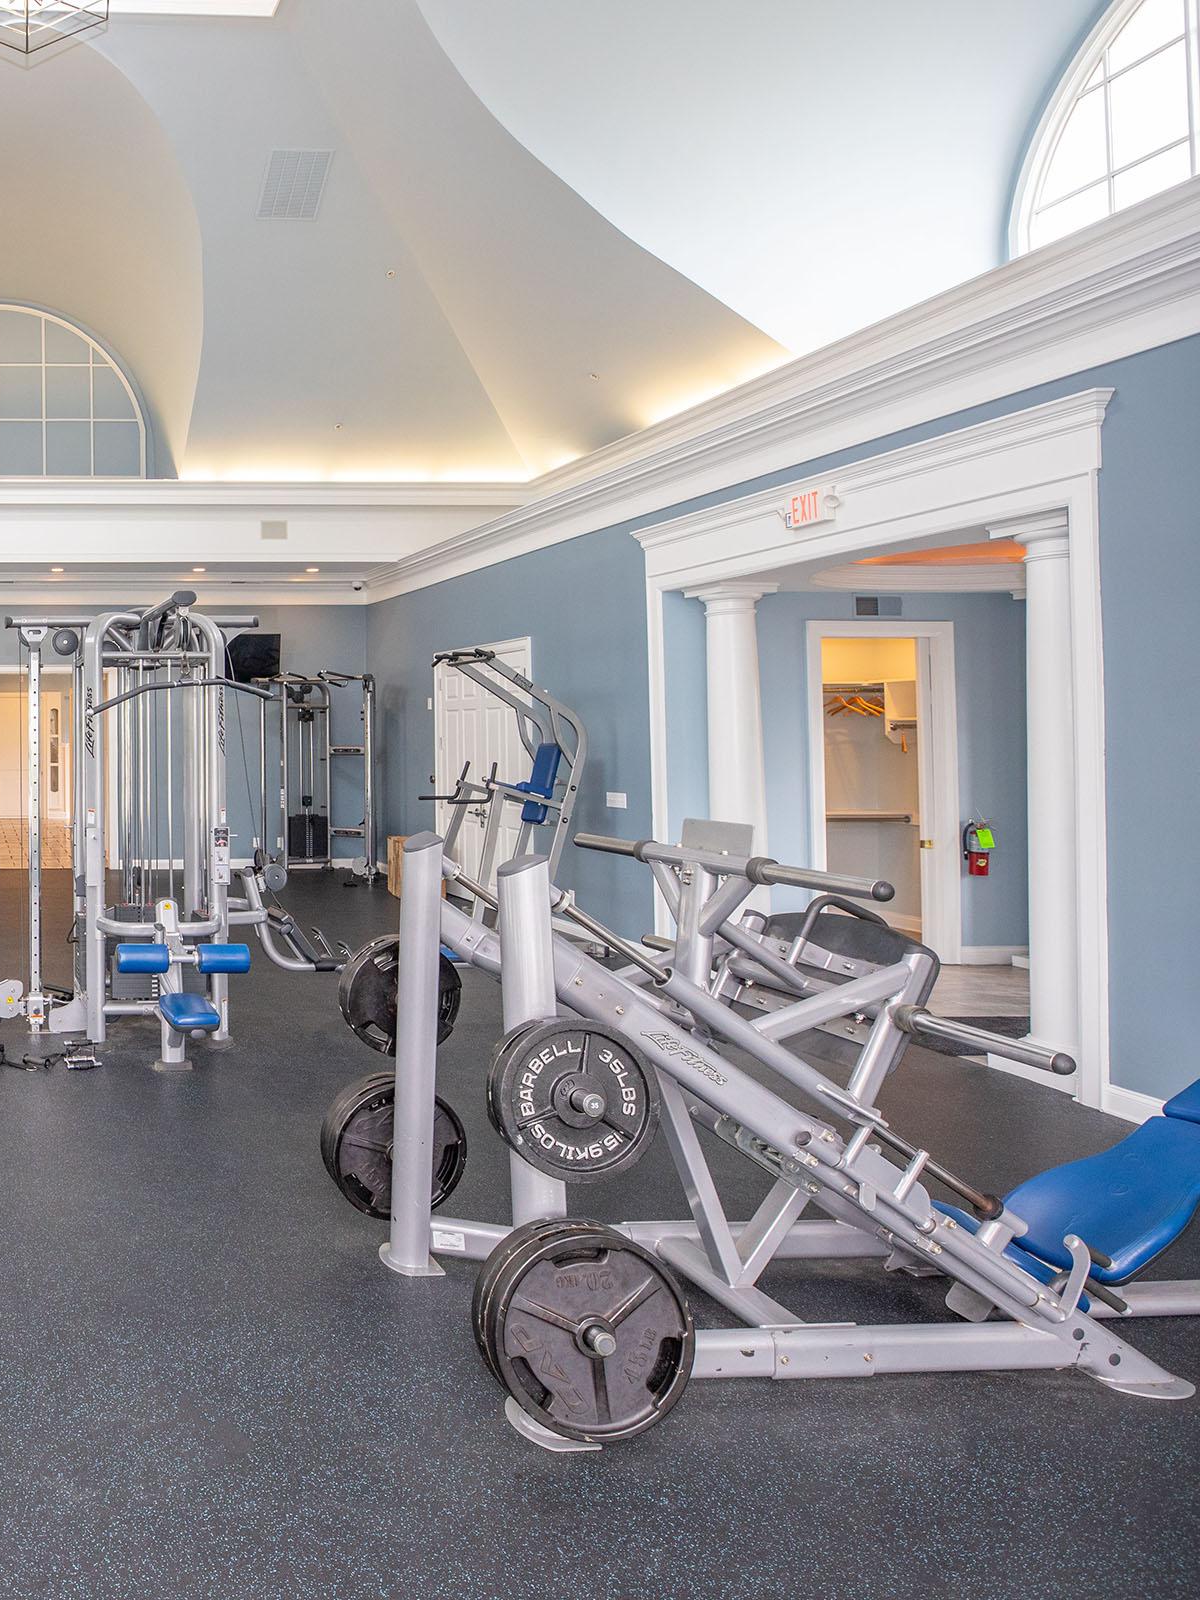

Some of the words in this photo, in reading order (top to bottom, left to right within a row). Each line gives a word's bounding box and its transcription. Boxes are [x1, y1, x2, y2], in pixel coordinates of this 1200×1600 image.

[792, 491, 818, 525] EXIT
[520, 1040, 581, 1117] BARBELL
[598, 1049, 637, 1116] 35LBS
[530, 1122, 624, 1161] 15.9KILOS
